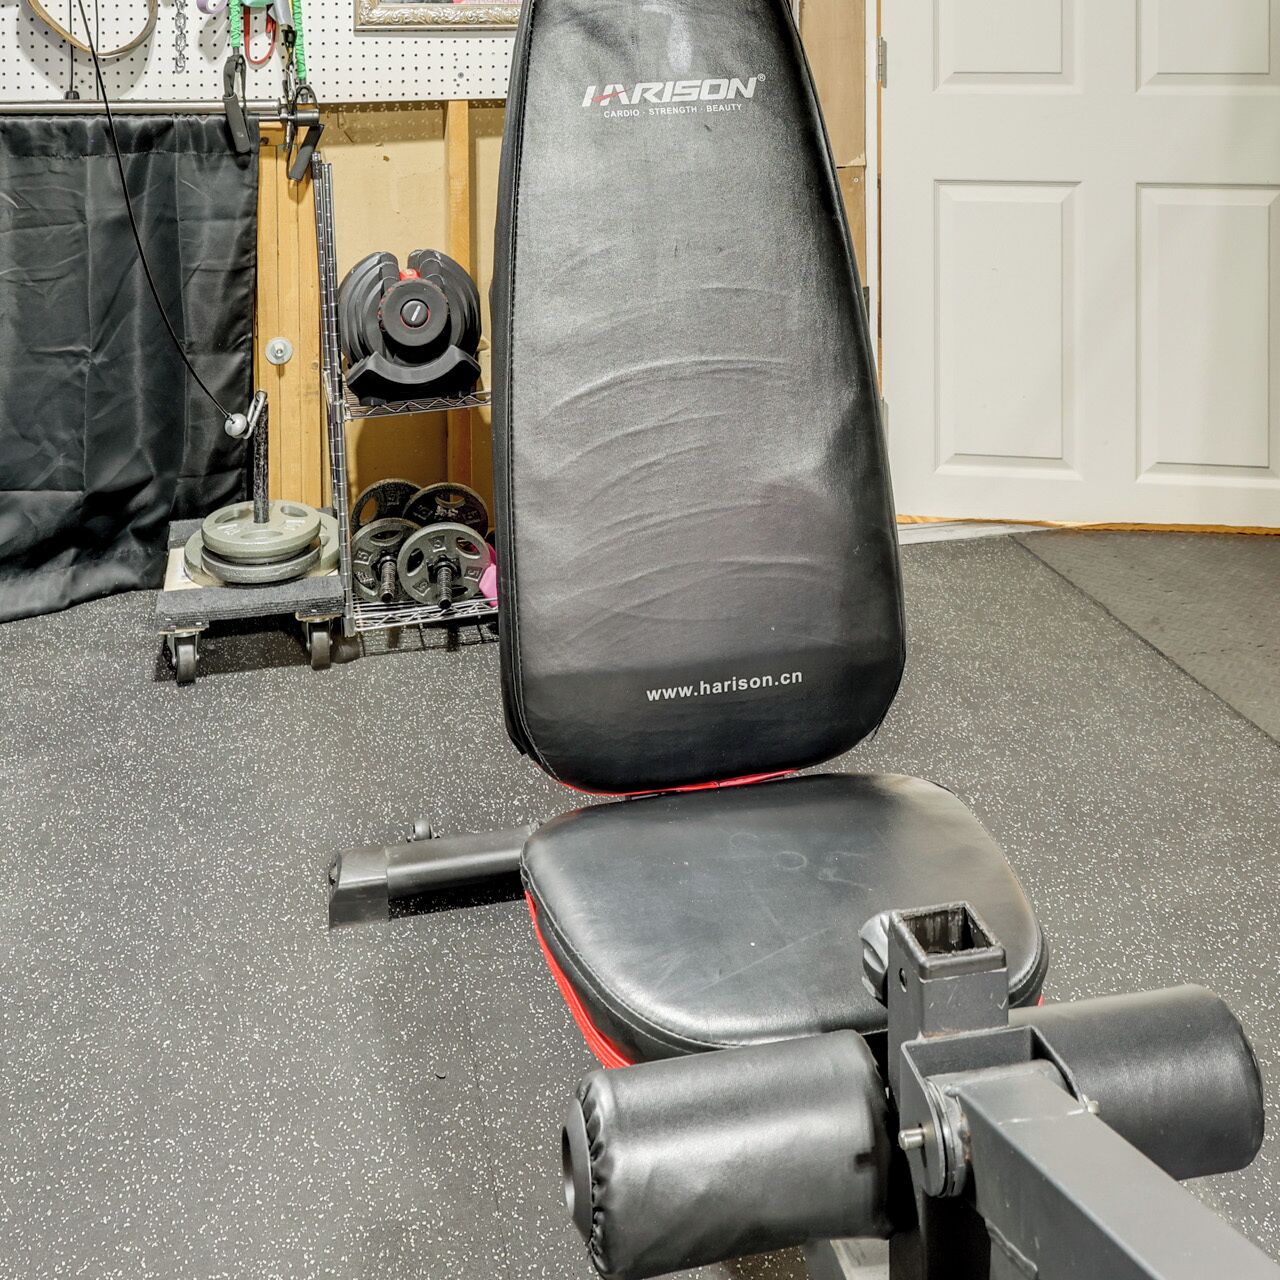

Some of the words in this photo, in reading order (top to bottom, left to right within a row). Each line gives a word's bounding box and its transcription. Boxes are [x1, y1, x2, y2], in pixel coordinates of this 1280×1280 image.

[603, 108, 641, 119] CARDIO
[648, 105, 698, 117] STRENGTH
[706, 103, 743, 113] BEAUTY
[646, 670, 803, 702] www.harison.cn
